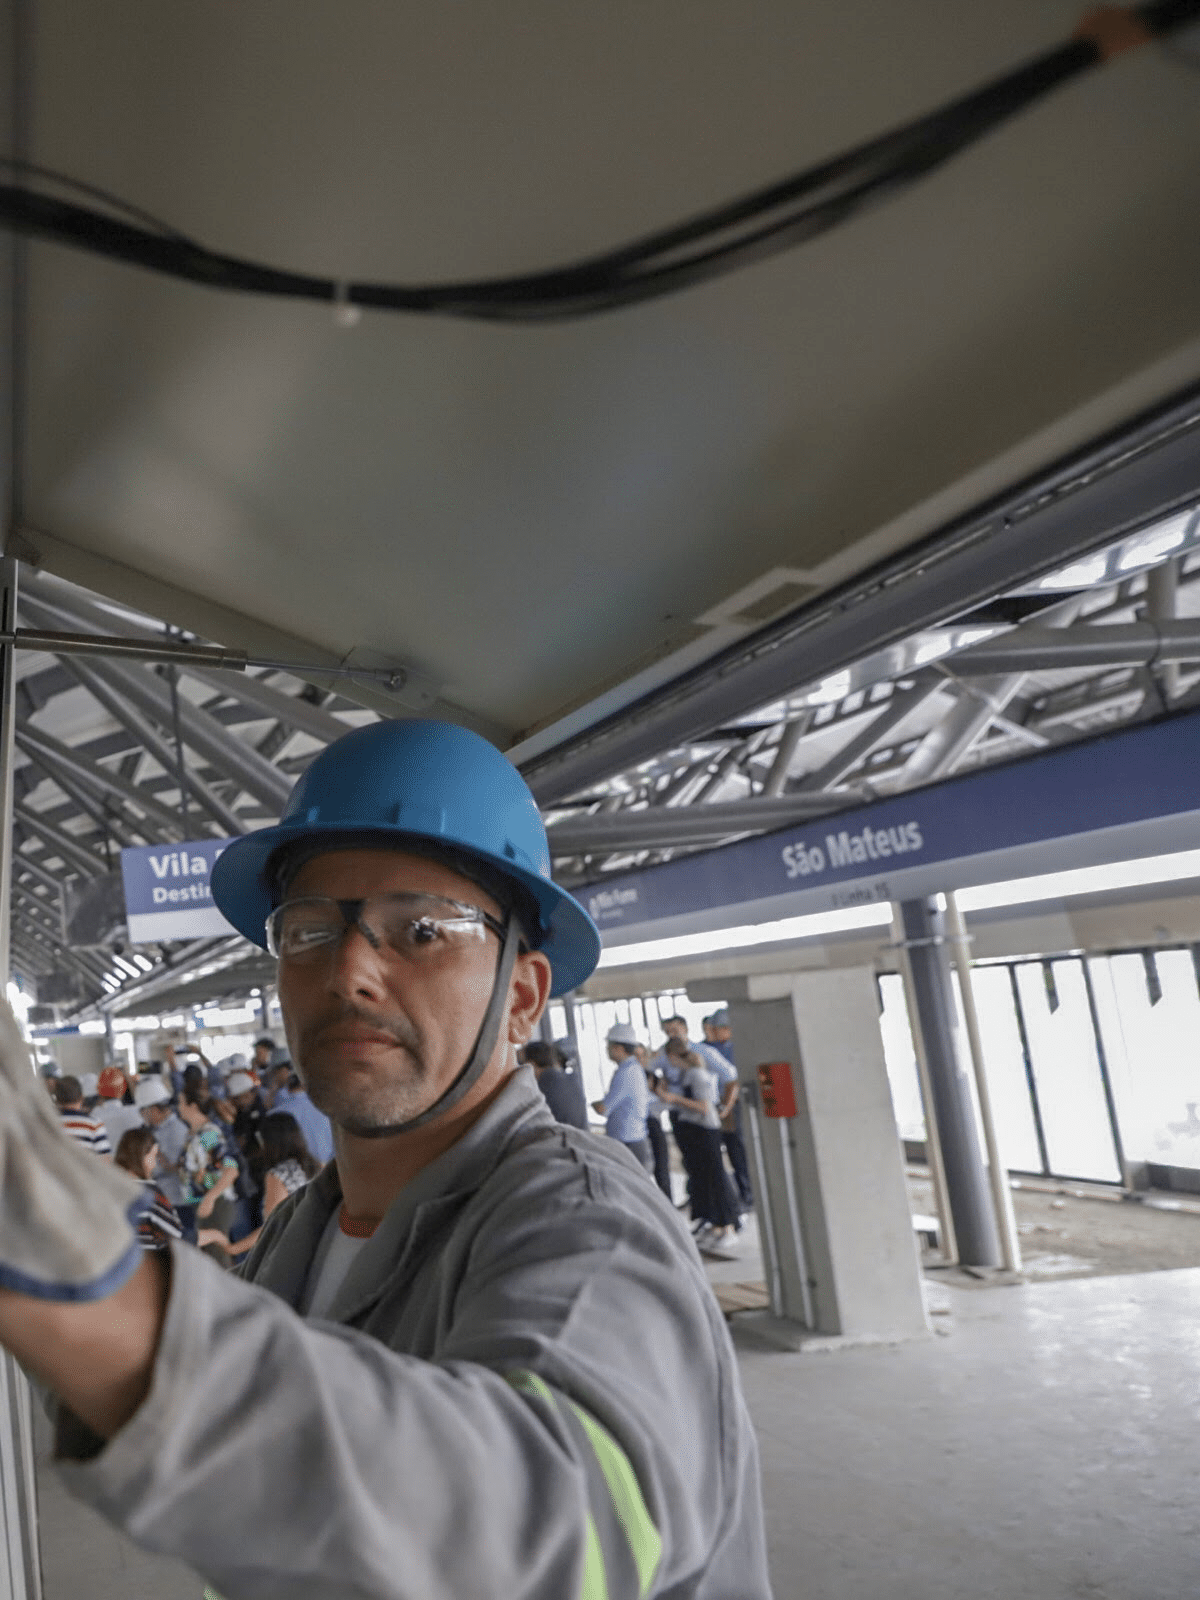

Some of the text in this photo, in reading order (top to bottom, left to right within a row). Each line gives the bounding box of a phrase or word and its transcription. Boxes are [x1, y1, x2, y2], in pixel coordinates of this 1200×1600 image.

[148, 851, 208, 879] Vila
[782, 821, 923, 879] São Mateus
